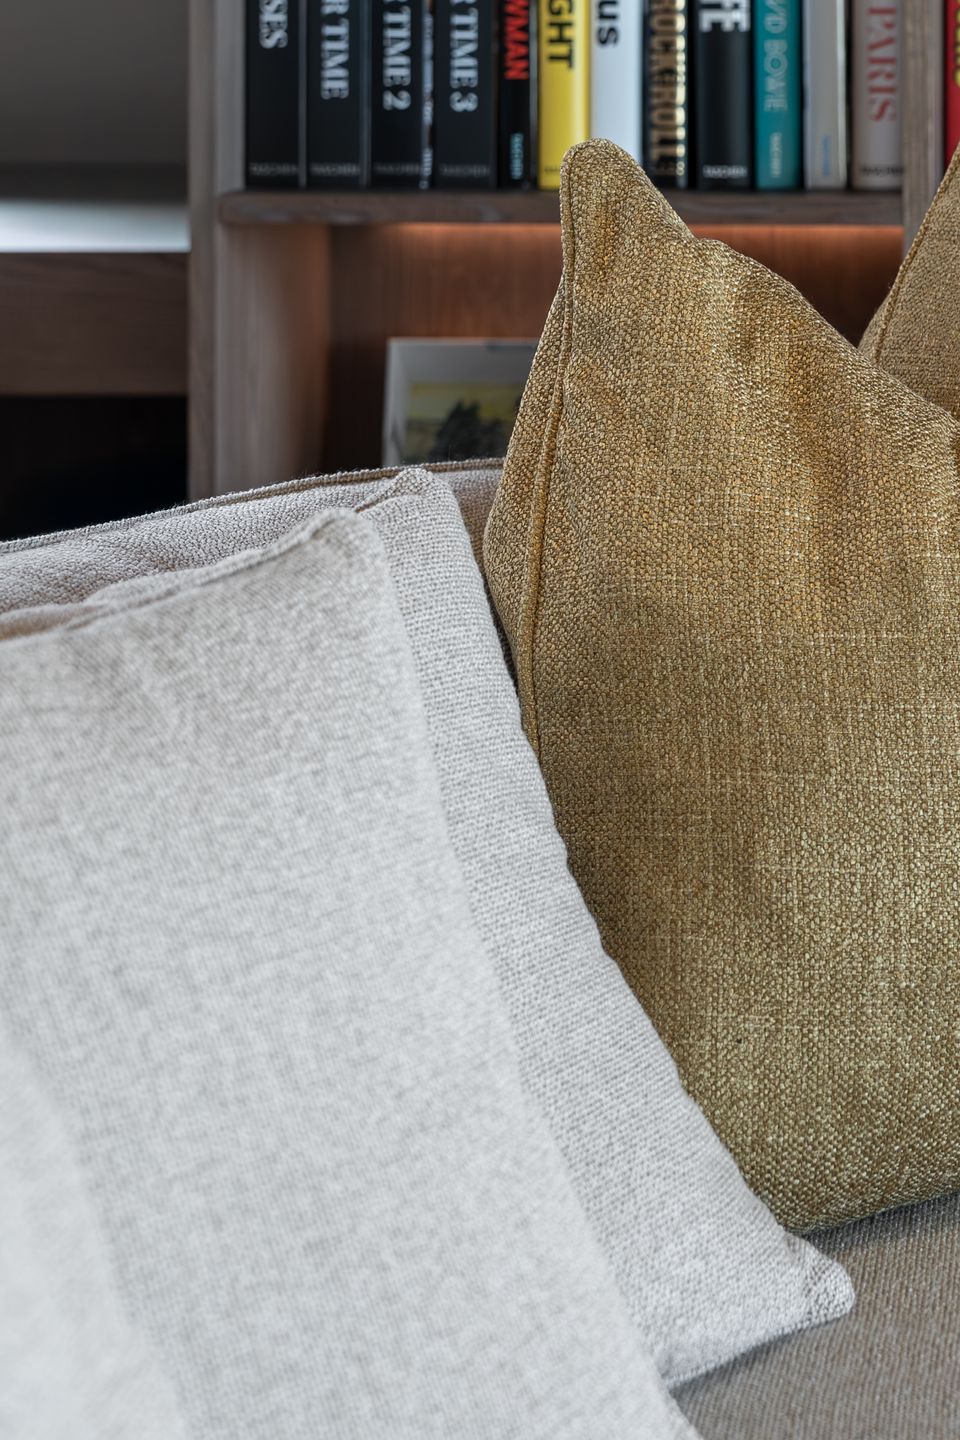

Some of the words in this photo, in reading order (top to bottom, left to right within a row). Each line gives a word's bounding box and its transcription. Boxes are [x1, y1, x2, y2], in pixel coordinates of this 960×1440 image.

[321, 19, 351, 100] TIME
[383, 6, 412, 87] TIME
[450, 8, 479, 88] TIME
[763, 40, 788, 111] BOWIE
[867, 7, 898, 123] PARIS
[383, 90, 412, 111] 2
[450, 91, 479, 112] 3
[648, 84, 686, 159] ROLL
